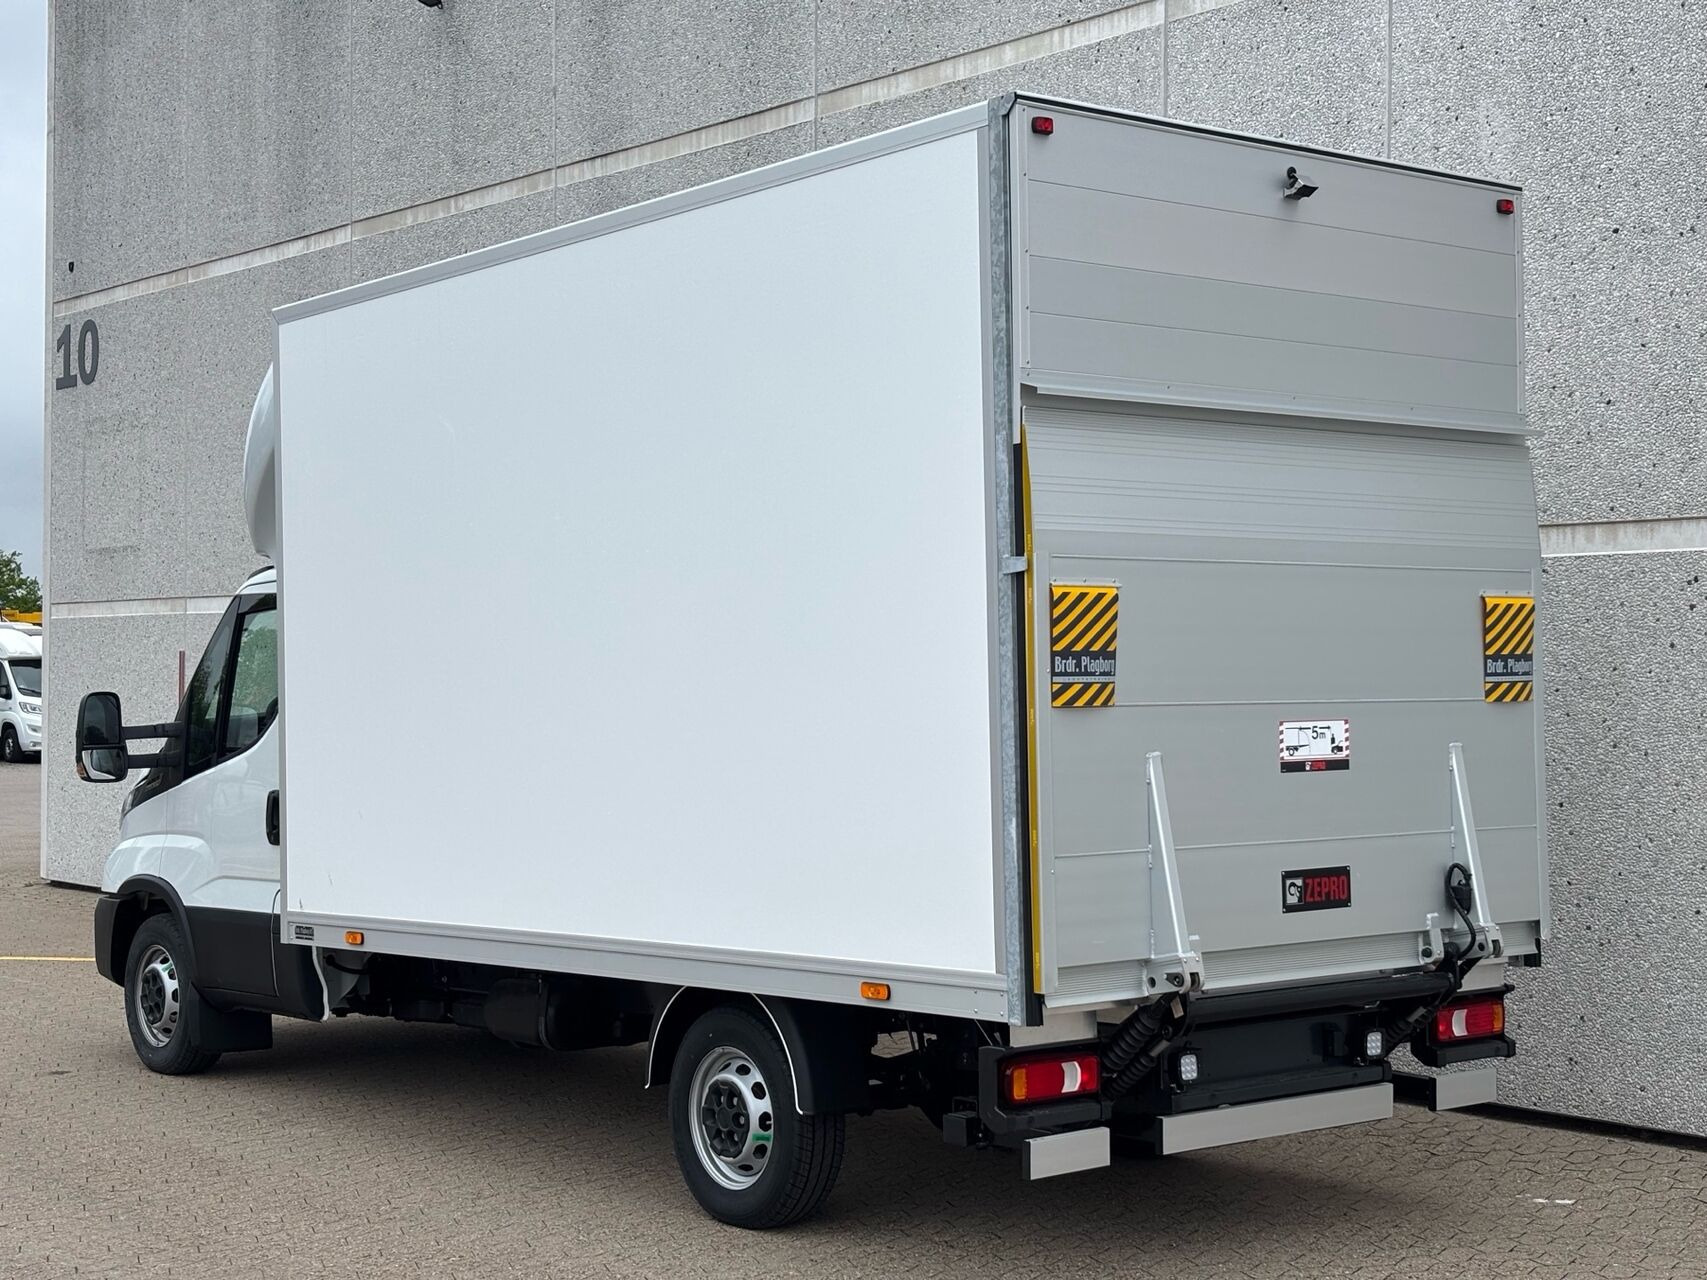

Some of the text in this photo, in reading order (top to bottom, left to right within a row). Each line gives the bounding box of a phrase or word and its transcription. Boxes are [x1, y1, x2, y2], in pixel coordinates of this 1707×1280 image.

[56, 319, 99, 390] 10
[1054, 656, 1079, 673] Brdr.
[1487, 658, 1506, 673] Brdr.
[1305, 875, 1348, 902] ZEPRO
